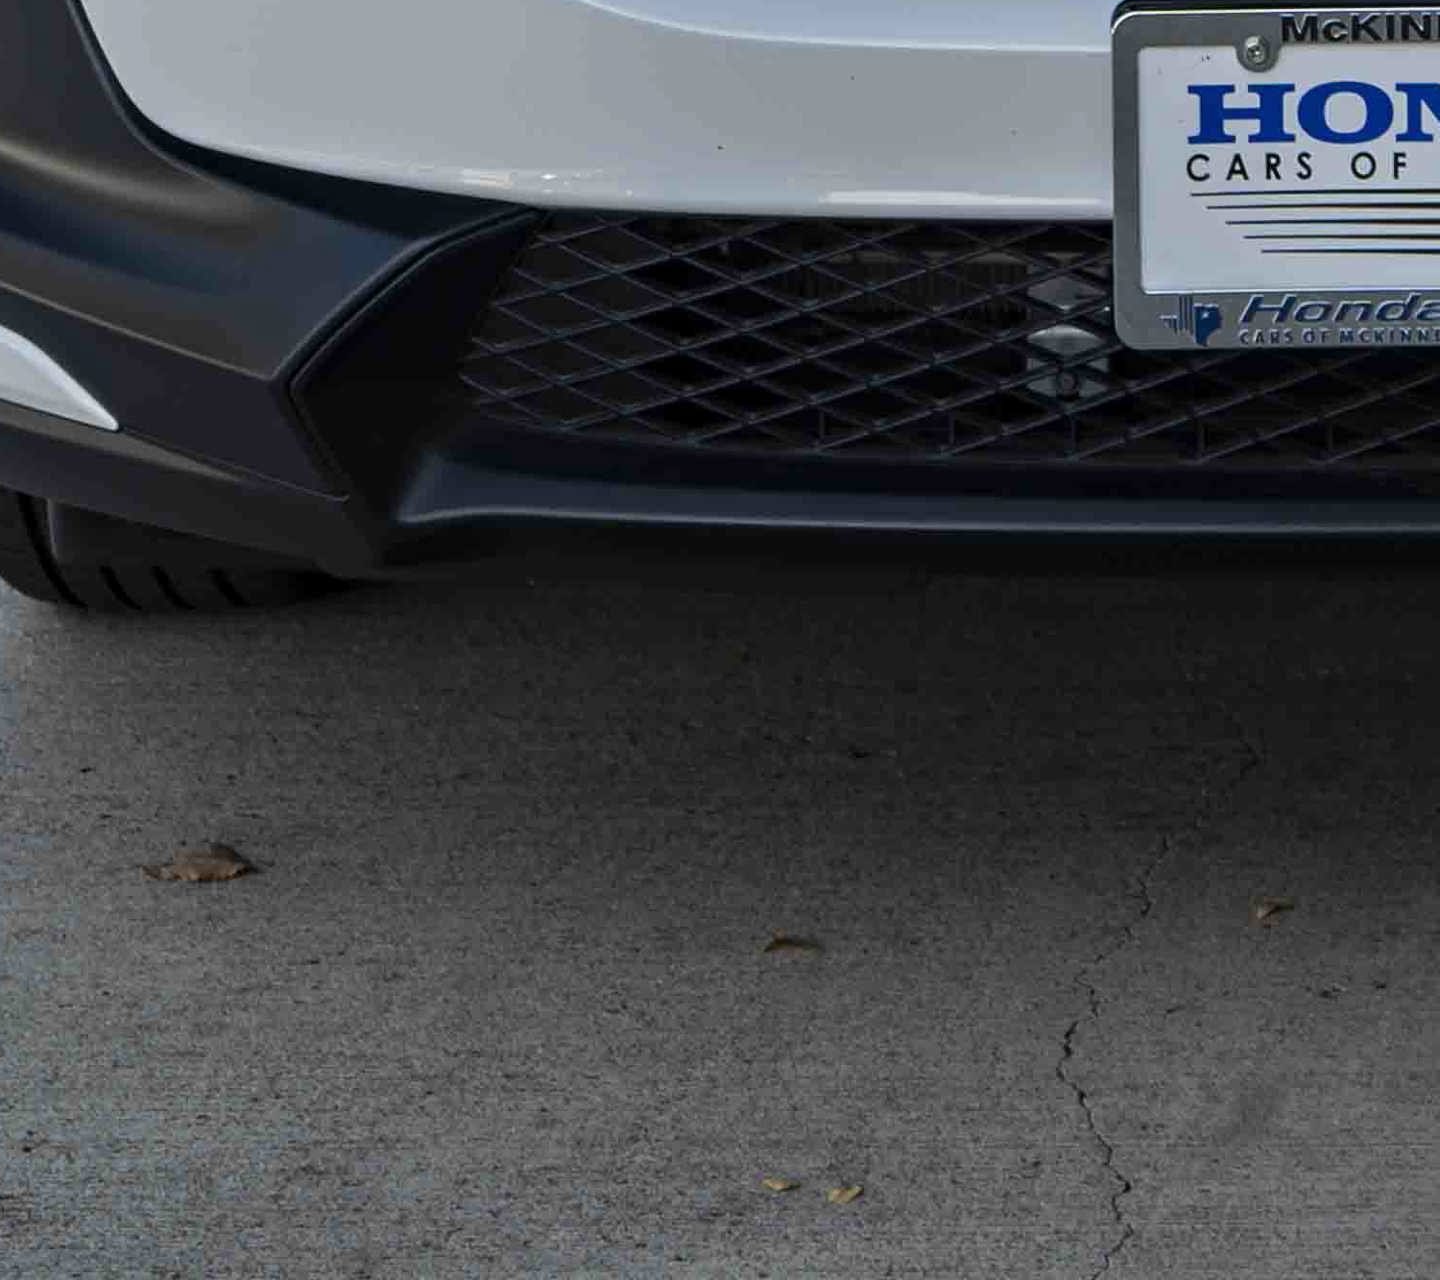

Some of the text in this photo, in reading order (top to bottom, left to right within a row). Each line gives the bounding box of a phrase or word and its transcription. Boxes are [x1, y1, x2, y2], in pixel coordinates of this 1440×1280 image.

[1186, 153, 1314, 182] CARS
[1350, 152, 1408, 182] OF
[1239, 329, 1294, 345] CARS
[1302, 329, 1331, 344] OF
